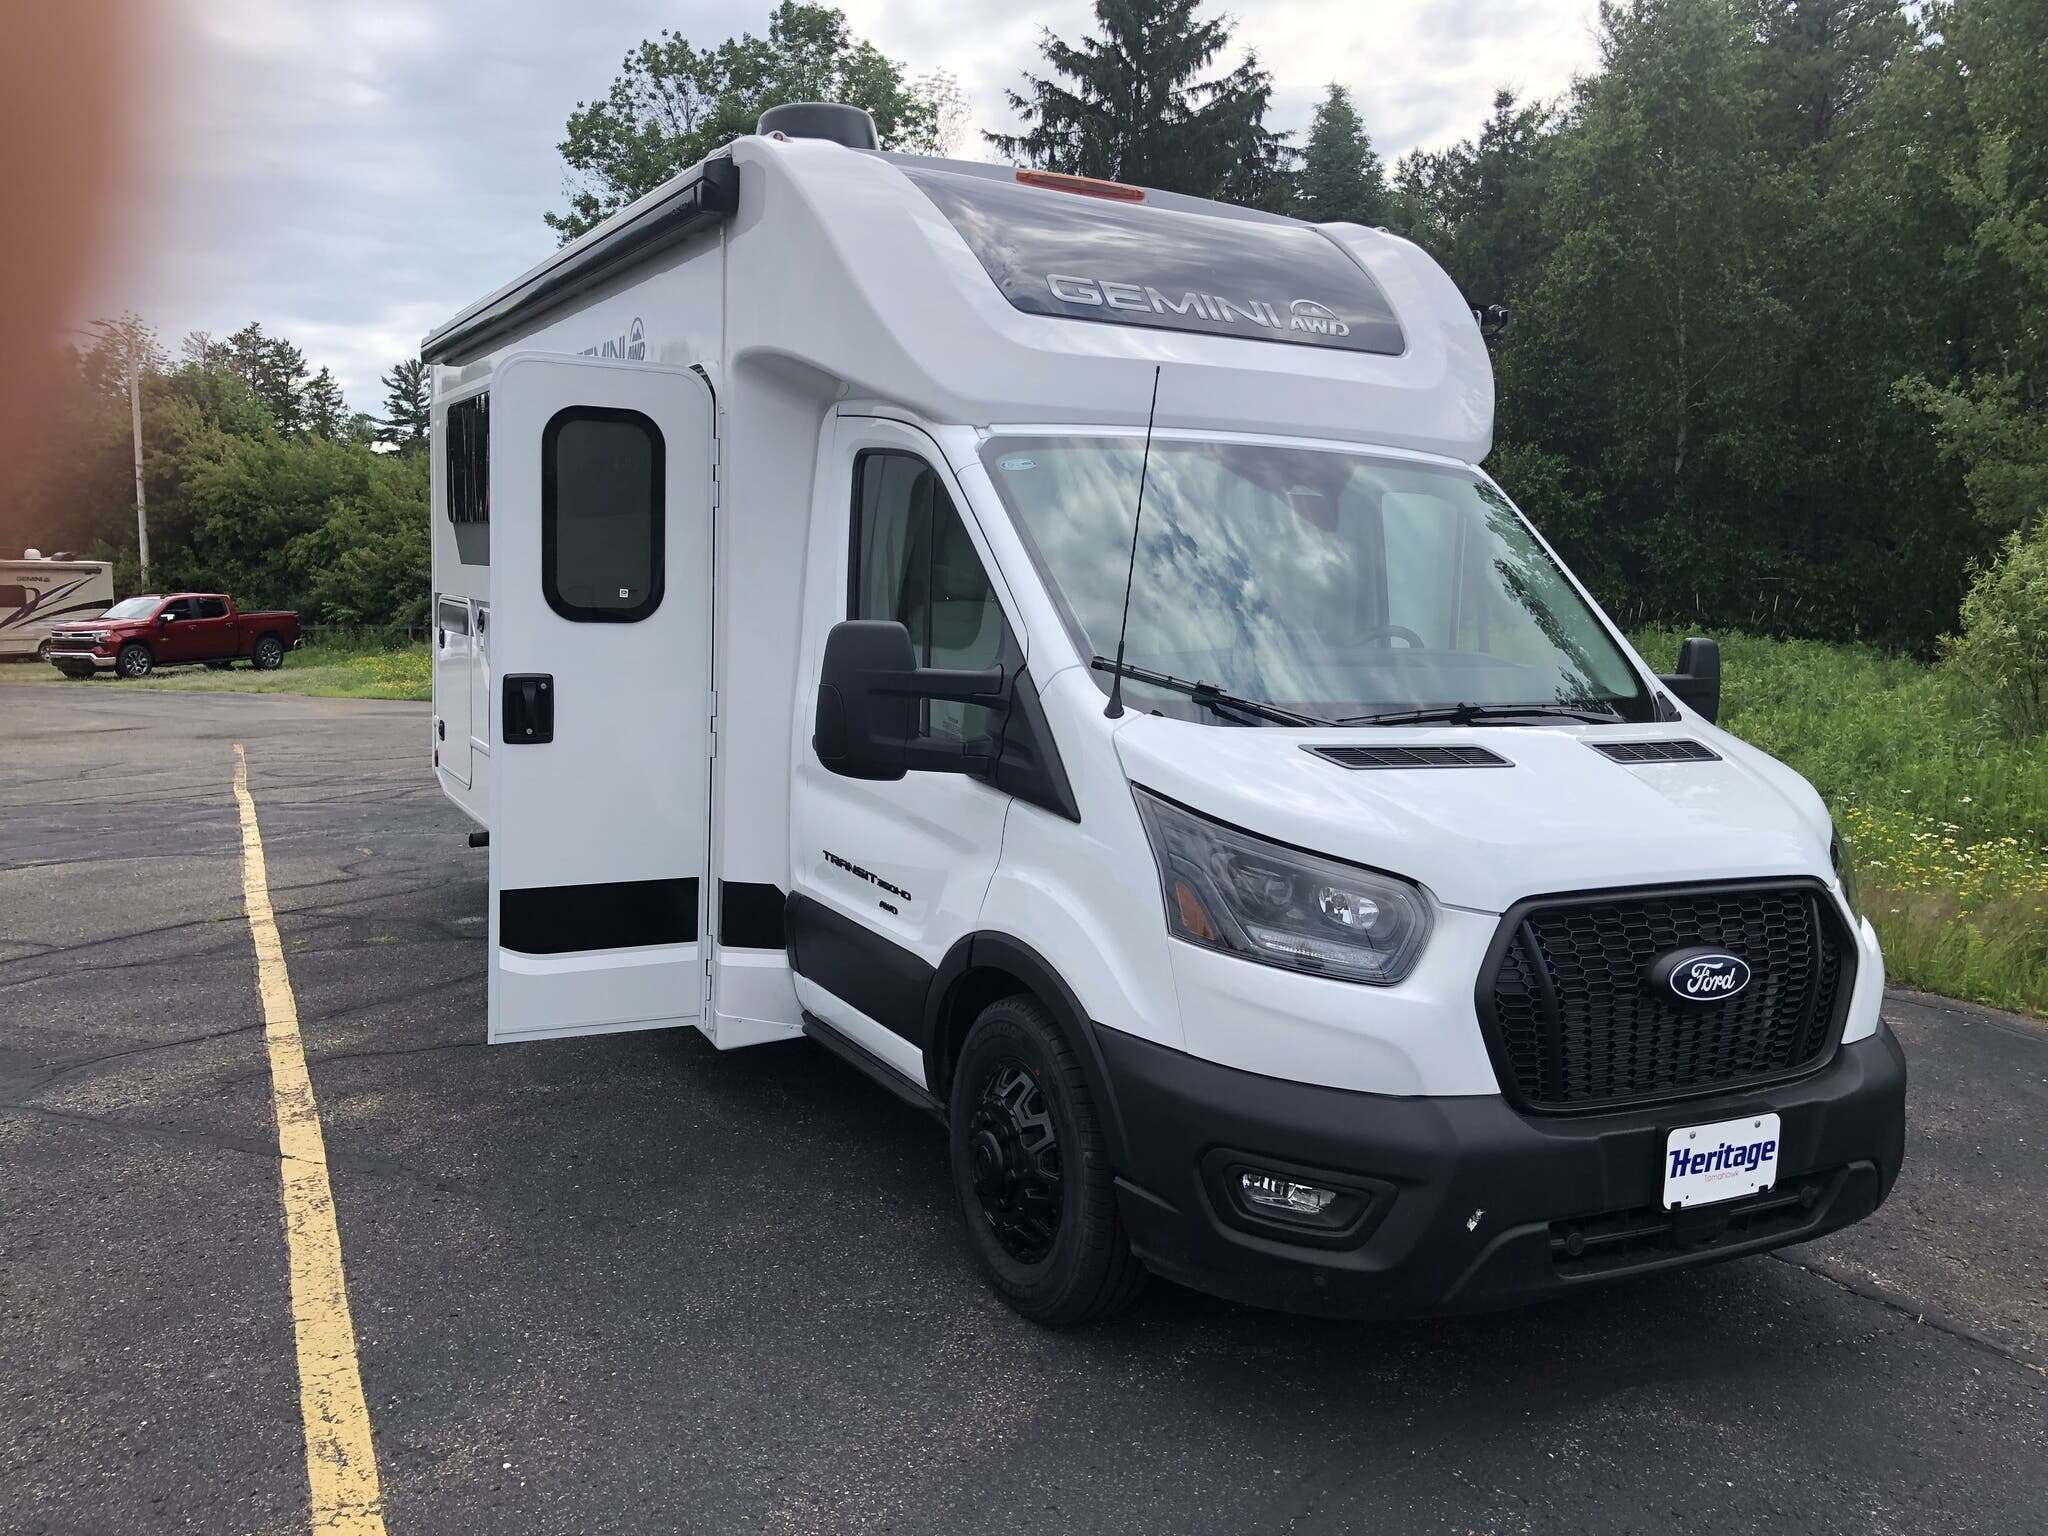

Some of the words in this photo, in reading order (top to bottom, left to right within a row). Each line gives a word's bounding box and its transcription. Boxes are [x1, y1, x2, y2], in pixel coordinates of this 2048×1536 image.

[1045, 273, 1283, 329] GEMINI
[1288, 319, 1350, 338] AWD
[822, 849, 877, 885] TRANSIT
[1686, 962, 1736, 993] Ford
[1669, 1140, 1776, 1179] Heritage
